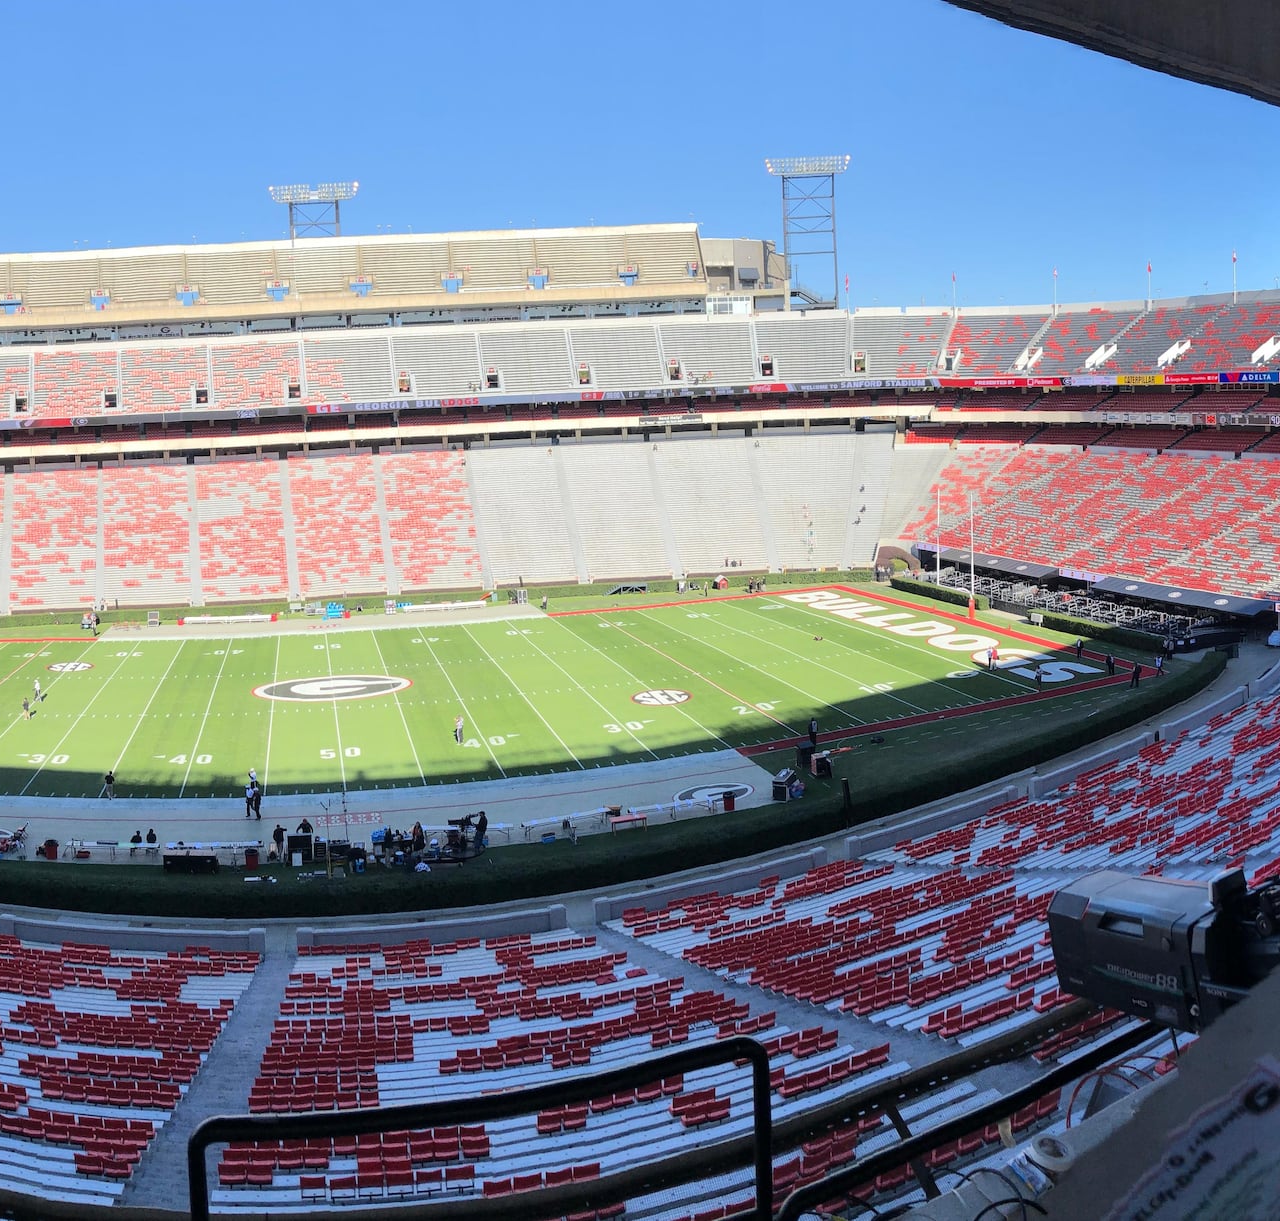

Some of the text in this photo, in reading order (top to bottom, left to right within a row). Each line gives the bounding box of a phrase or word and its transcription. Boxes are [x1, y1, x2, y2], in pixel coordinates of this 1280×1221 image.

[840, 380, 882, 389] SANFORD
[885, 379, 926, 388] STADIUM
[1124, 376, 1155, 384] CATERPILLAR
[355, 398, 479, 410] GEORGIA BULLDOGS
[780, 591, 1106, 683] BULLDOGS
[48, 662, 93, 672] SEC
[858, 682, 894, 693] 10
[632, 689, 692, 706] SEC
[732, 702, 775, 716] 20
[603, 721, 644, 733] 30
[463, 735, 506, 748] 40
[27, 754, 70, 764] 30
[320, 747, 361, 759] 50
[169, 754, 213, 765] 40
